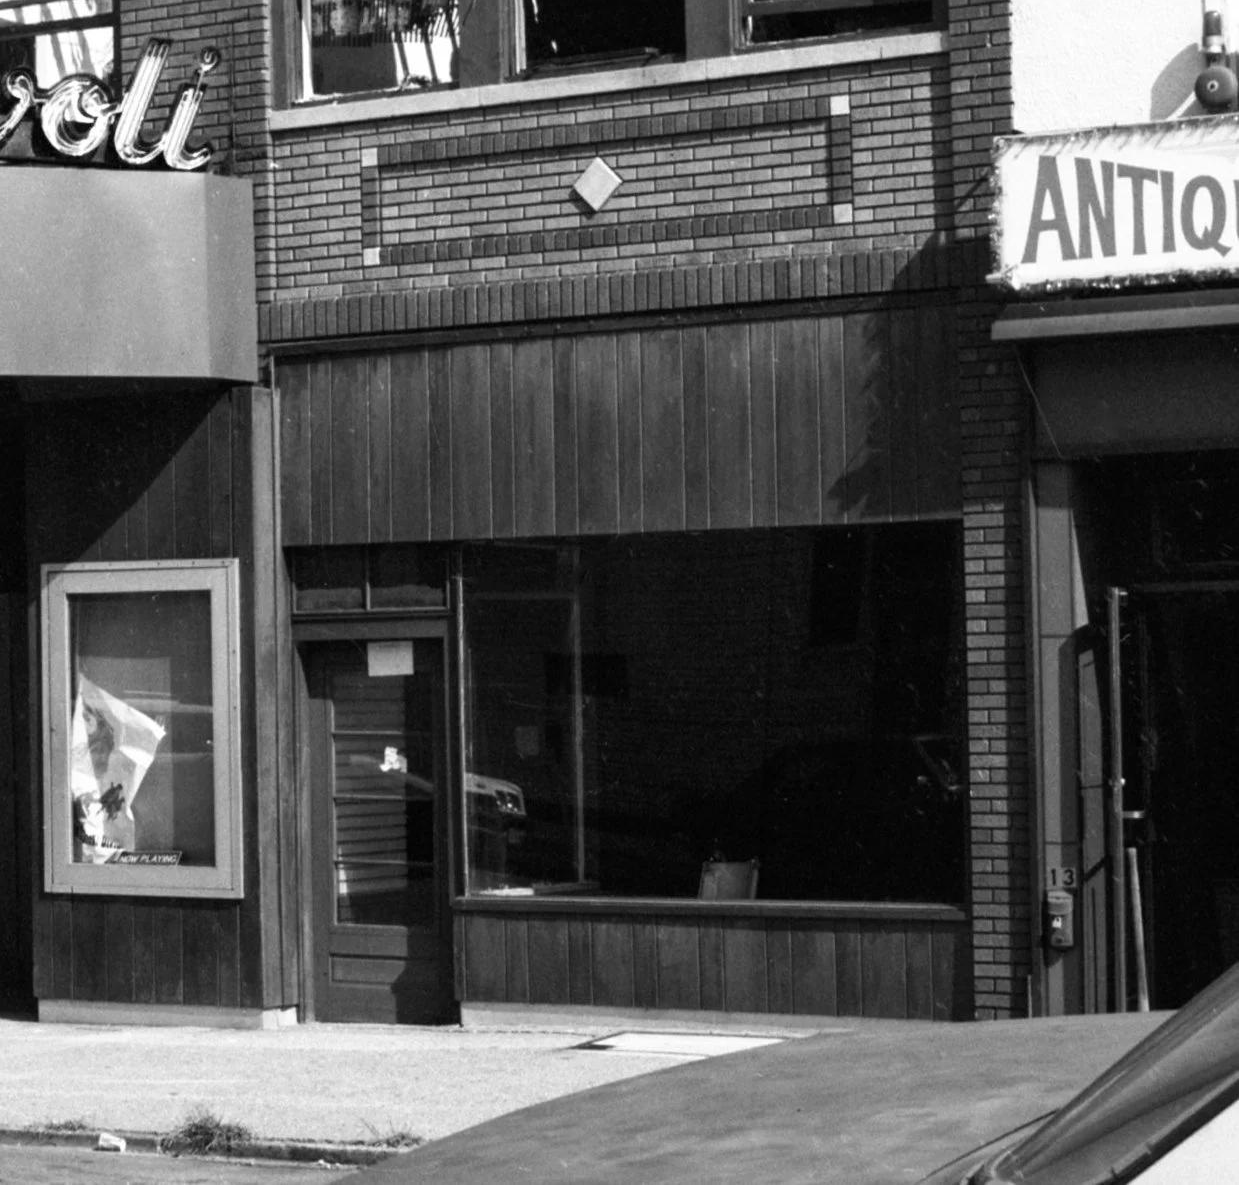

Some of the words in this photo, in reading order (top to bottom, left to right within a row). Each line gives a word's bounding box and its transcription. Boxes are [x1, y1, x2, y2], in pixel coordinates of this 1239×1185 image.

[1020, 154, 1239, 265] ANTIQ
[139, 854, 177, 863] PLAYING
[1050, 868, 1075, 886] 13
